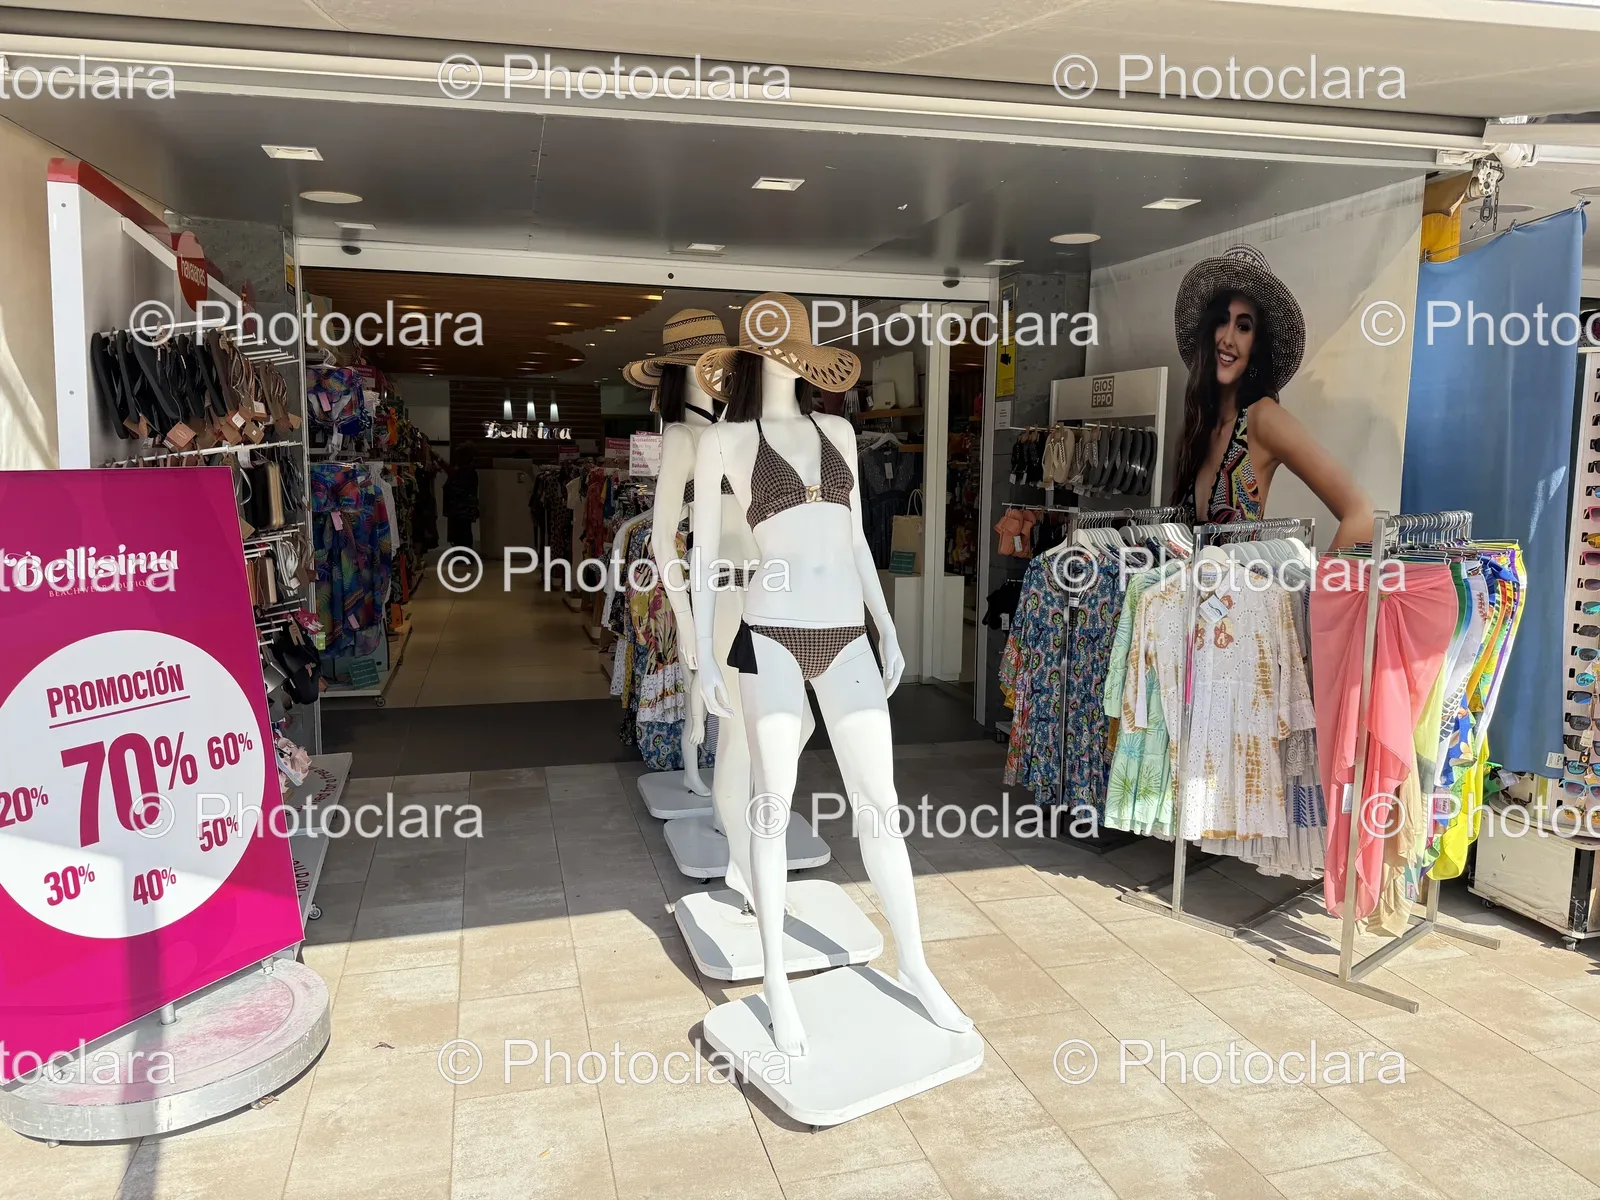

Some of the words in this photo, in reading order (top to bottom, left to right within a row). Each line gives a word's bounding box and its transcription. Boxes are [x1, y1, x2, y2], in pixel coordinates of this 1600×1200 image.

[1092, 393, 1112, 406] EPPO
[1093, 379, 1113, 393] GIOS
[3, 543, 179, 588] Bellisima
[46, 661, 185, 718] PROMOCIÓN
[206, 732, 253, 770] 60%
[0, 785, 49, 829] 20%
[60, 731, 199, 848] 70%
[199, 815, 239, 852] 50%
[43, 863, 96, 906] 30%
[132, 867, 177, 906] 40%
